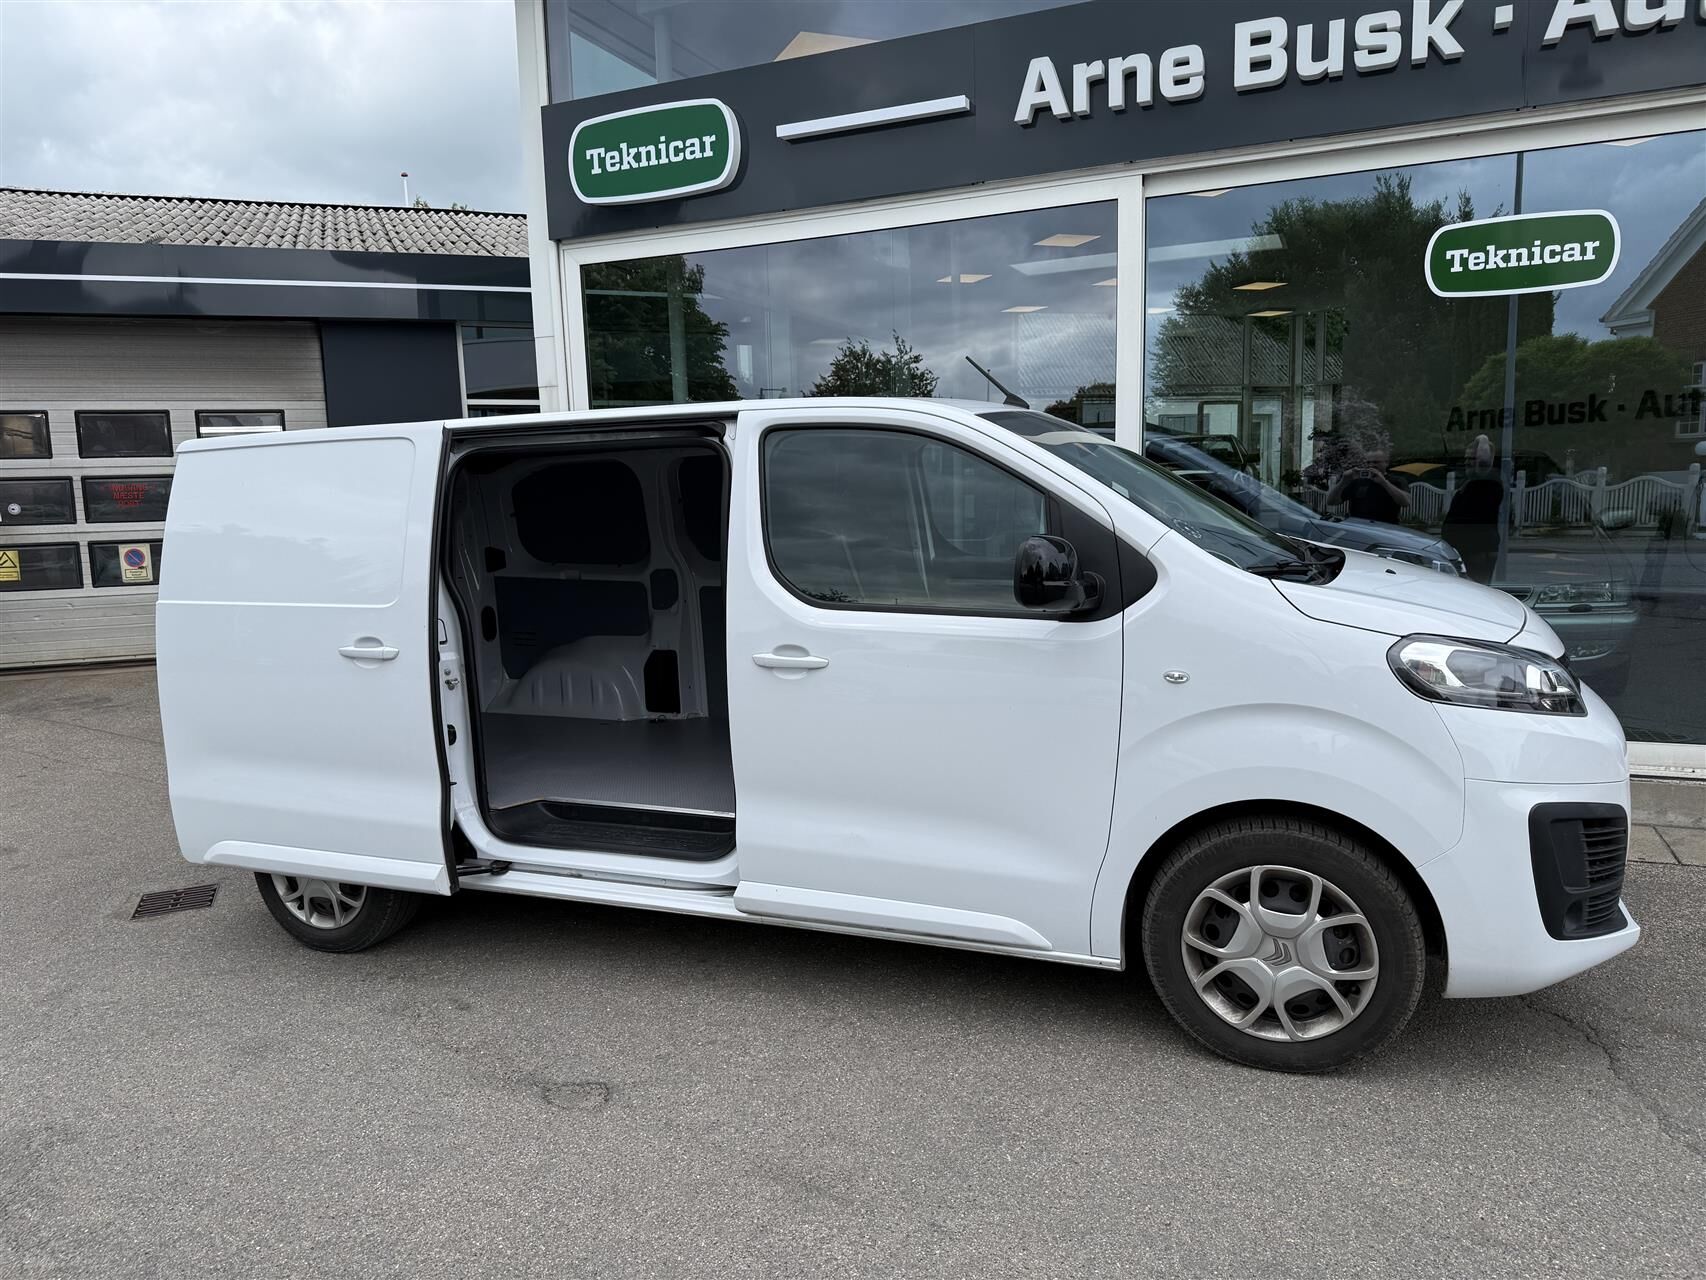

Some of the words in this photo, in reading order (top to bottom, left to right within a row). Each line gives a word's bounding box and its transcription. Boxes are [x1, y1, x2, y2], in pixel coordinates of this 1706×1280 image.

[1014, 44, 1205, 124] Arne
[1233, 0, 1465, 91] Busk
[1543, 0, 1706, 45] Au
[586, 134, 716, 175] Teknicar
[1446, 240, 1600, 273] Teknicar
[1446, 406, 1516, 432] Arne
[1524, 392, 1608, 427] Busk
